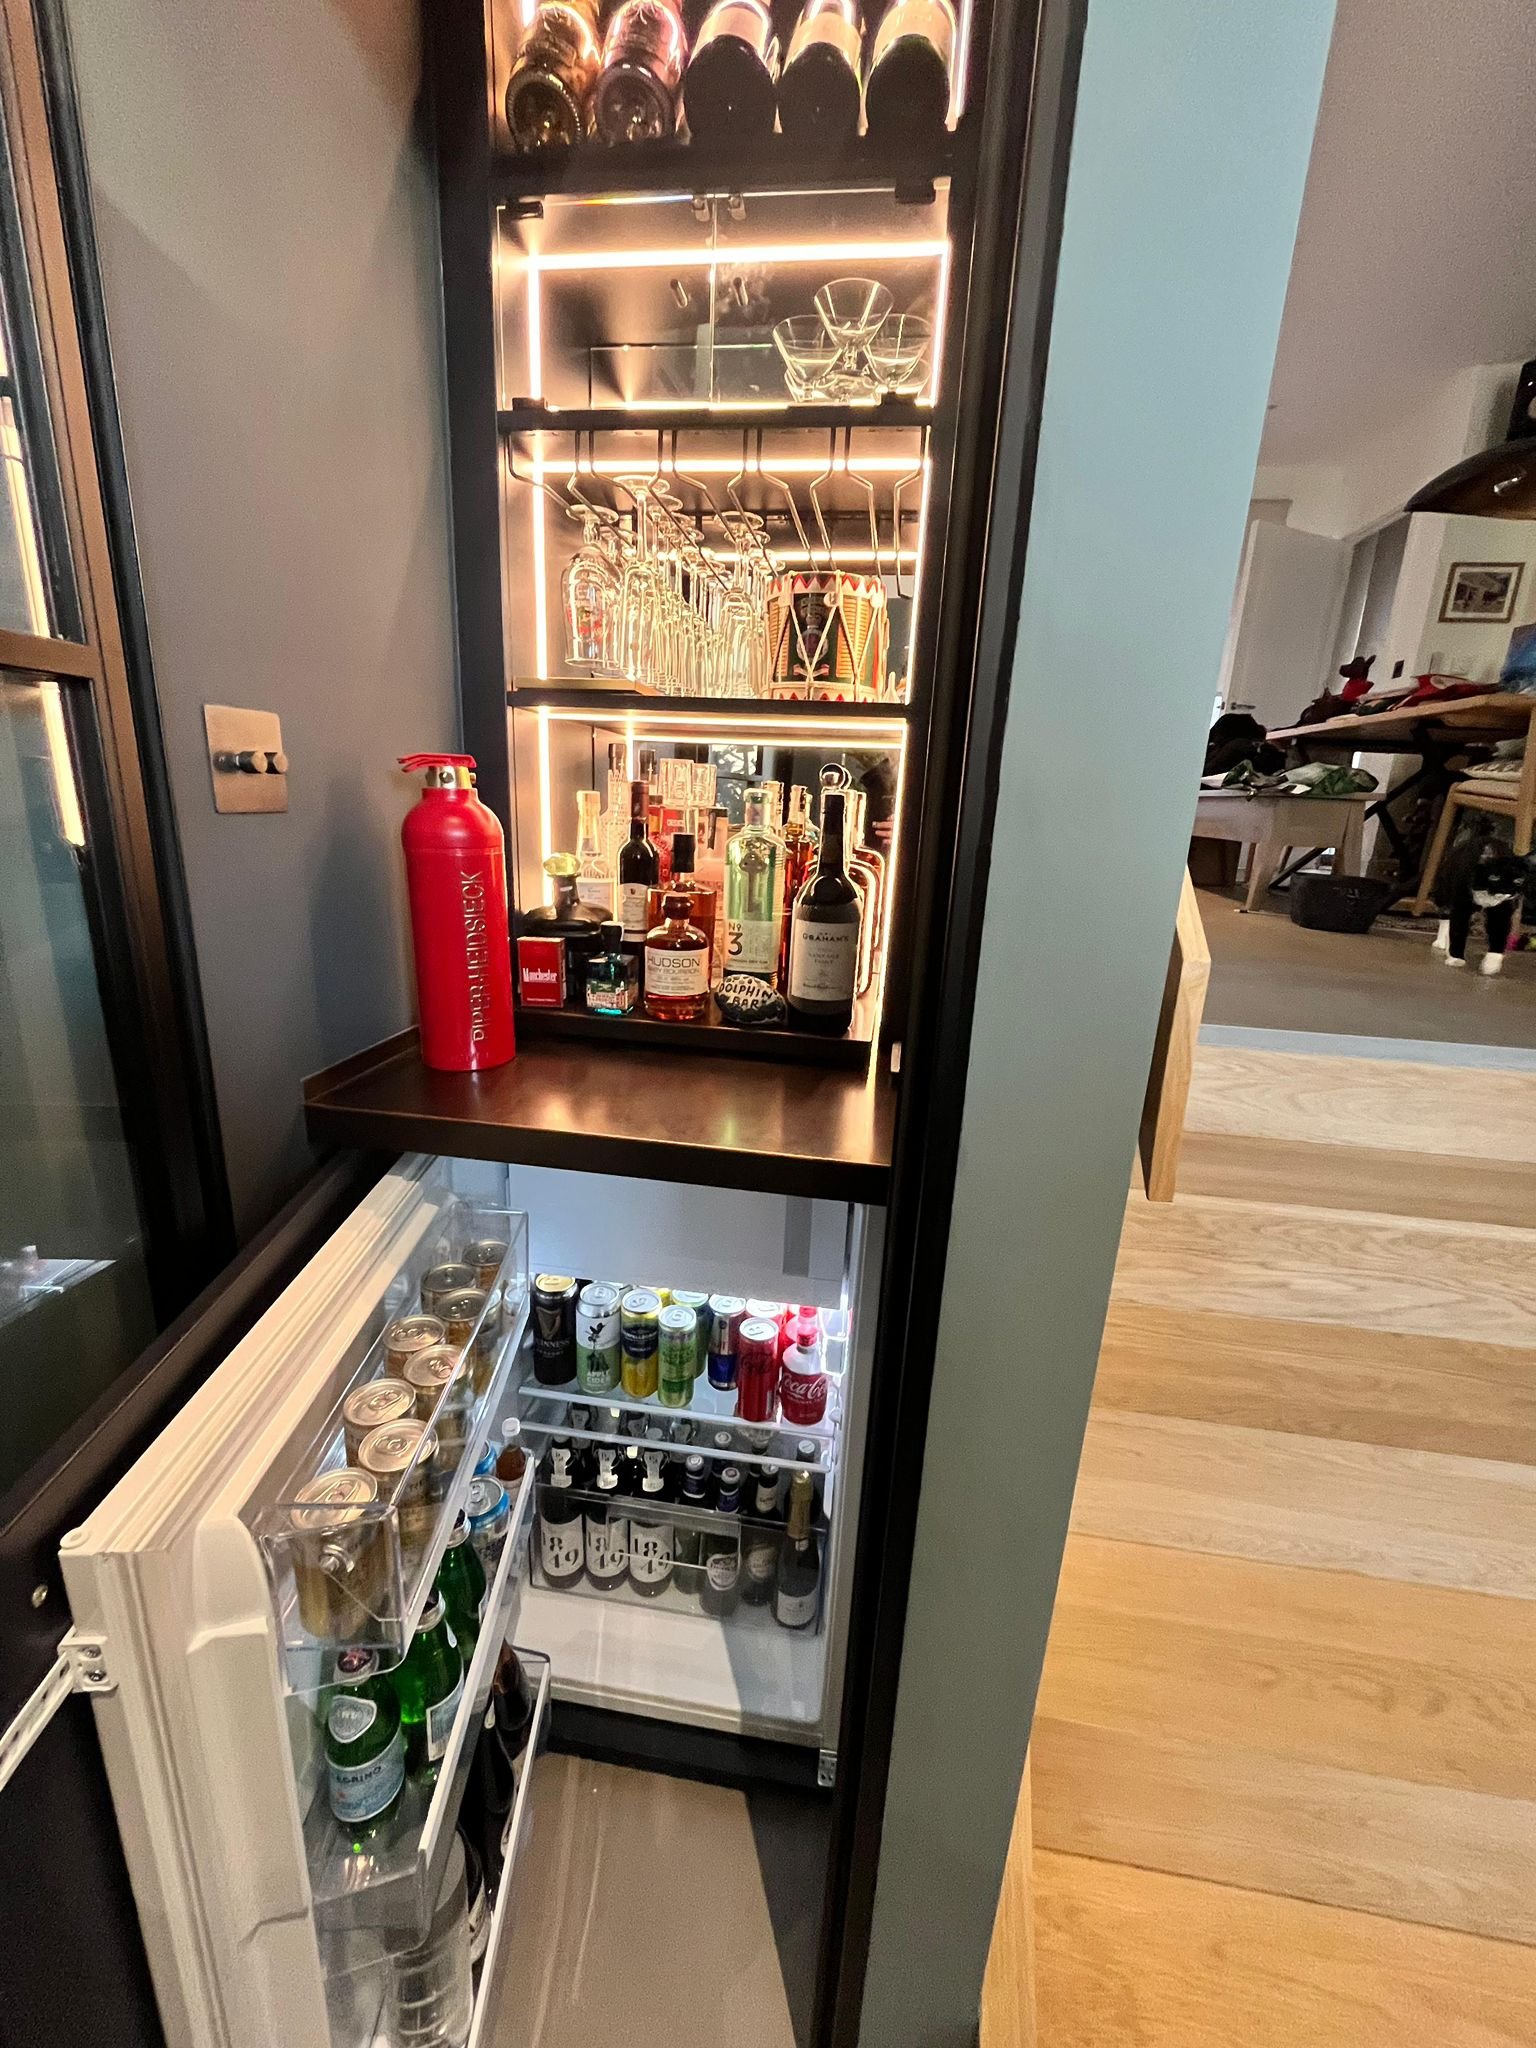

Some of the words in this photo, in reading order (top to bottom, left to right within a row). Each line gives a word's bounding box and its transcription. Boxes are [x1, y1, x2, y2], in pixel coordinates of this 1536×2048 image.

[728, 932, 743, 956] 3
[647, 956, 701, 968] HUDSON
[522, 967, 558, 984] Manchester
